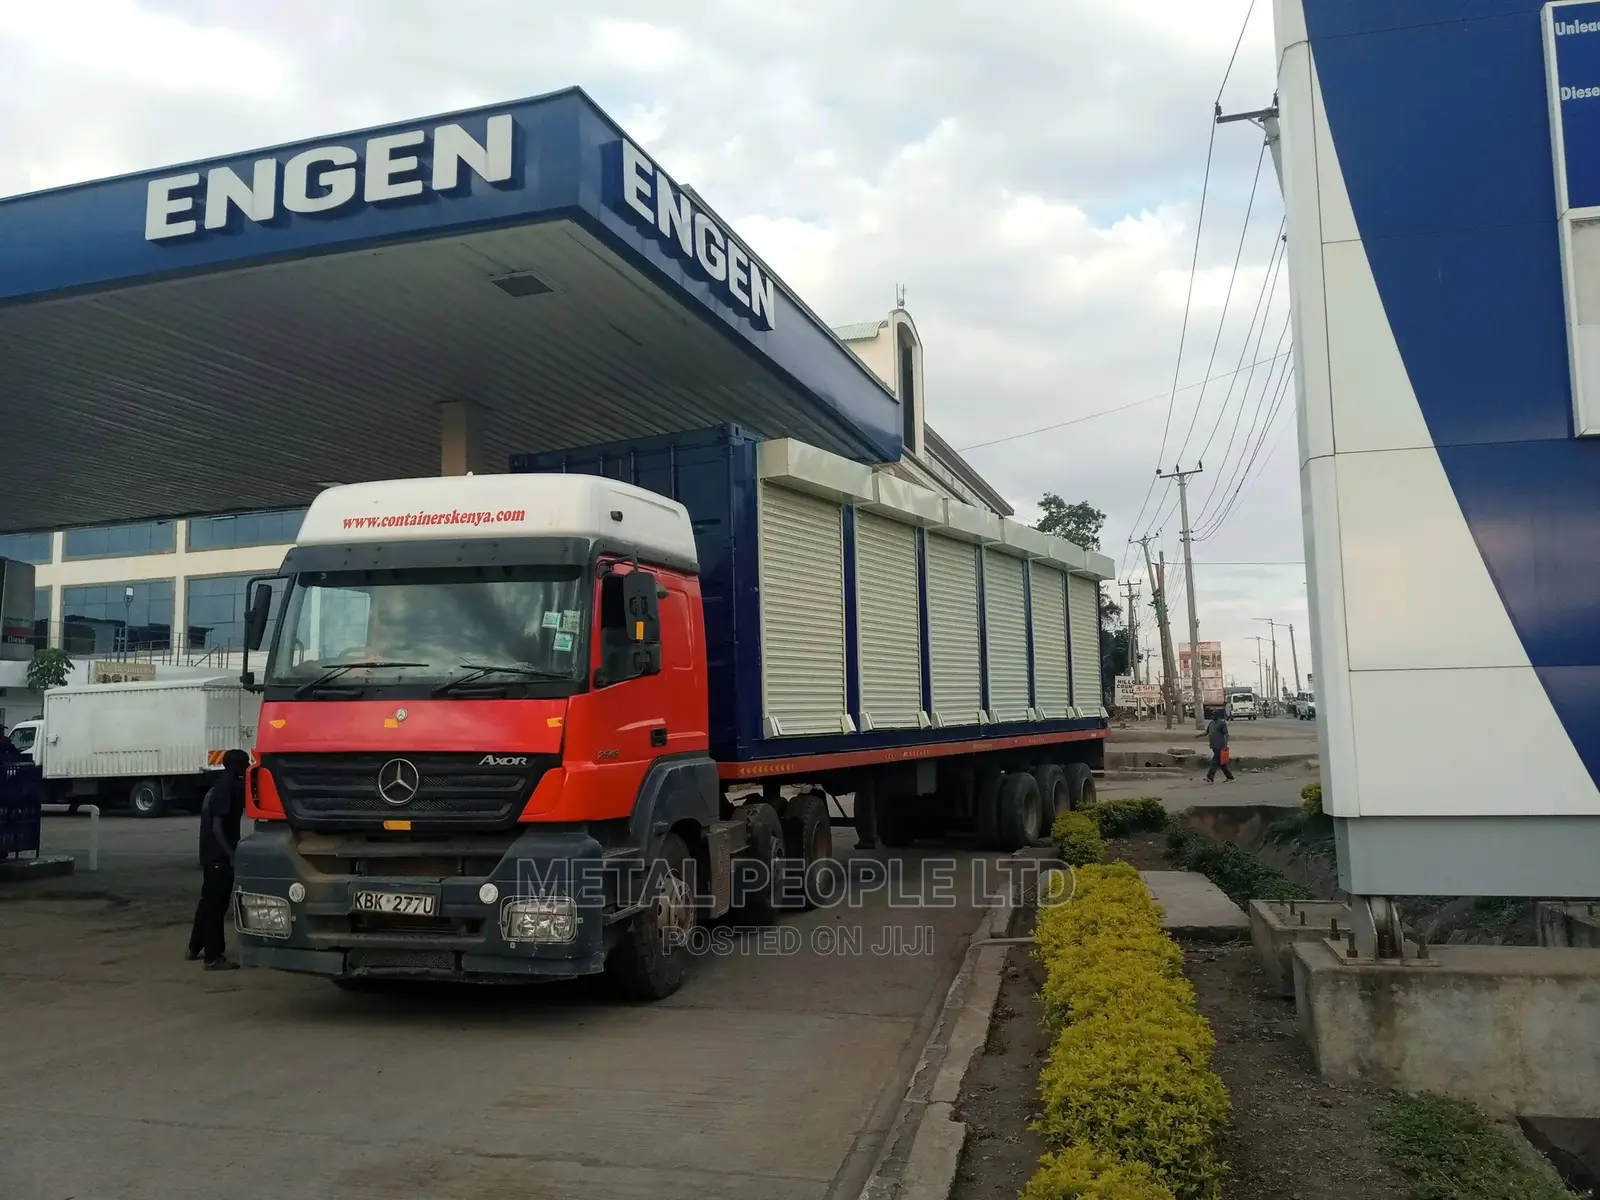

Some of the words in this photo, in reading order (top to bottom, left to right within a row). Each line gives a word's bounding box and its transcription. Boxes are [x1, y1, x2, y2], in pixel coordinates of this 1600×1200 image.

[144, 114, 513, 241] ENGEN
[622, 137, 775, 331] ENGEN
[342, 508, 526, 530] www.containerskenya.com
[478, 754, 527, 766] AXOR
[354, 892, 384, 910] KBK
[391, 895, 434, 914] 277U
